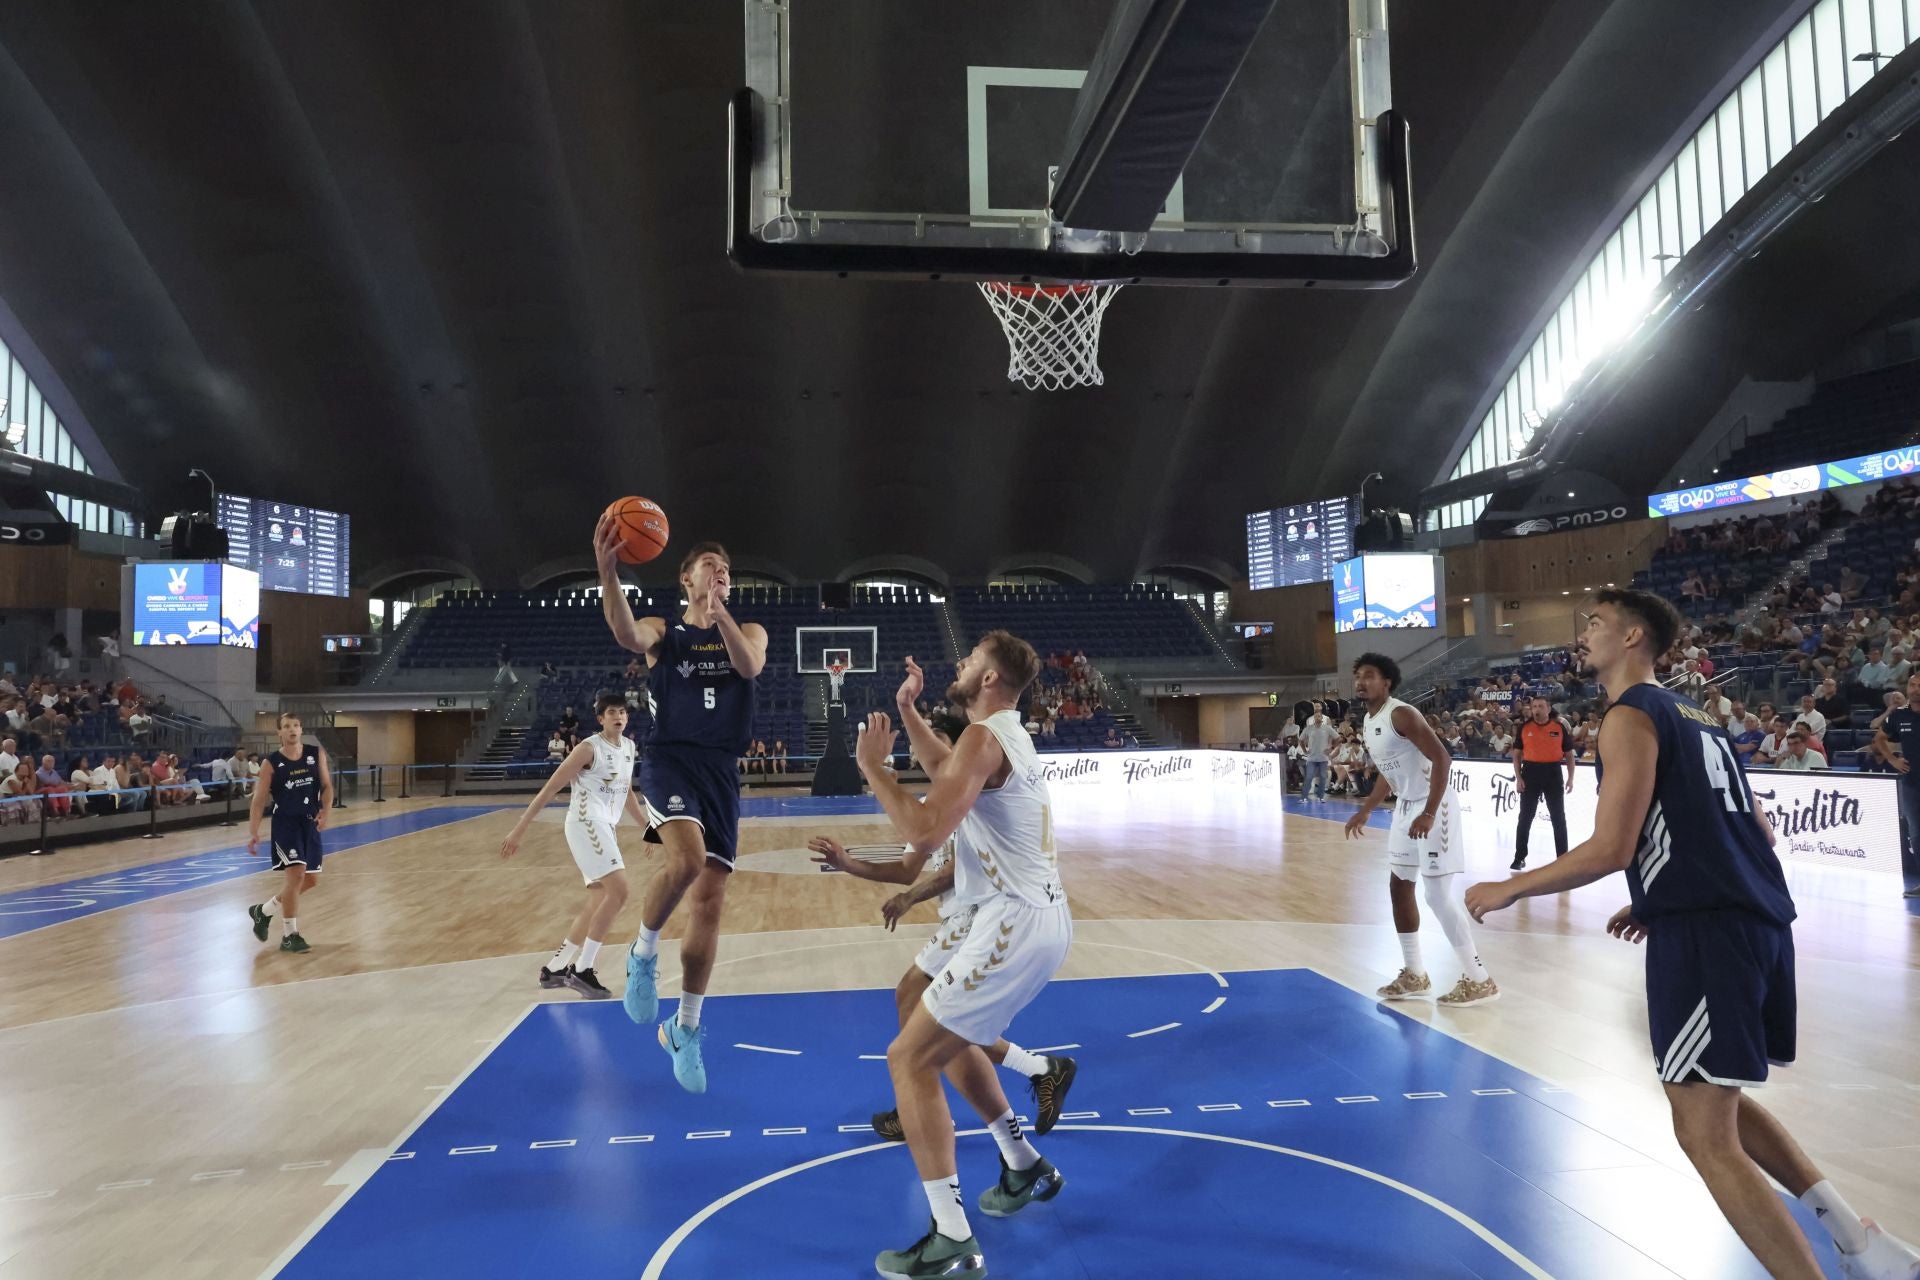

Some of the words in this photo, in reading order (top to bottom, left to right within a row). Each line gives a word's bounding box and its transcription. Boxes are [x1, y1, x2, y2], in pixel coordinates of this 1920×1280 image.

[1715, 482, 1738, 492] OVIEDO
[1680, 489, 1714, 510] OVD
[273, 505, 280, 515] 6
[294, 508, 301, 518] 5
[1289, 508, 1294, 517] 6
[1307, 505, 1312, 514] 5
[278, 558, 295, 567] 7:25
[1296, 554, 1310, 562] 7:25
[703, 687, 715, 709] 5
[1481, 690, 1512, 701] BURGOS
[1123, 754, 1192, 784] Floridita
[1700, 730, 1751, 812] 41
[1753, 788, 1863, 837] oridita
